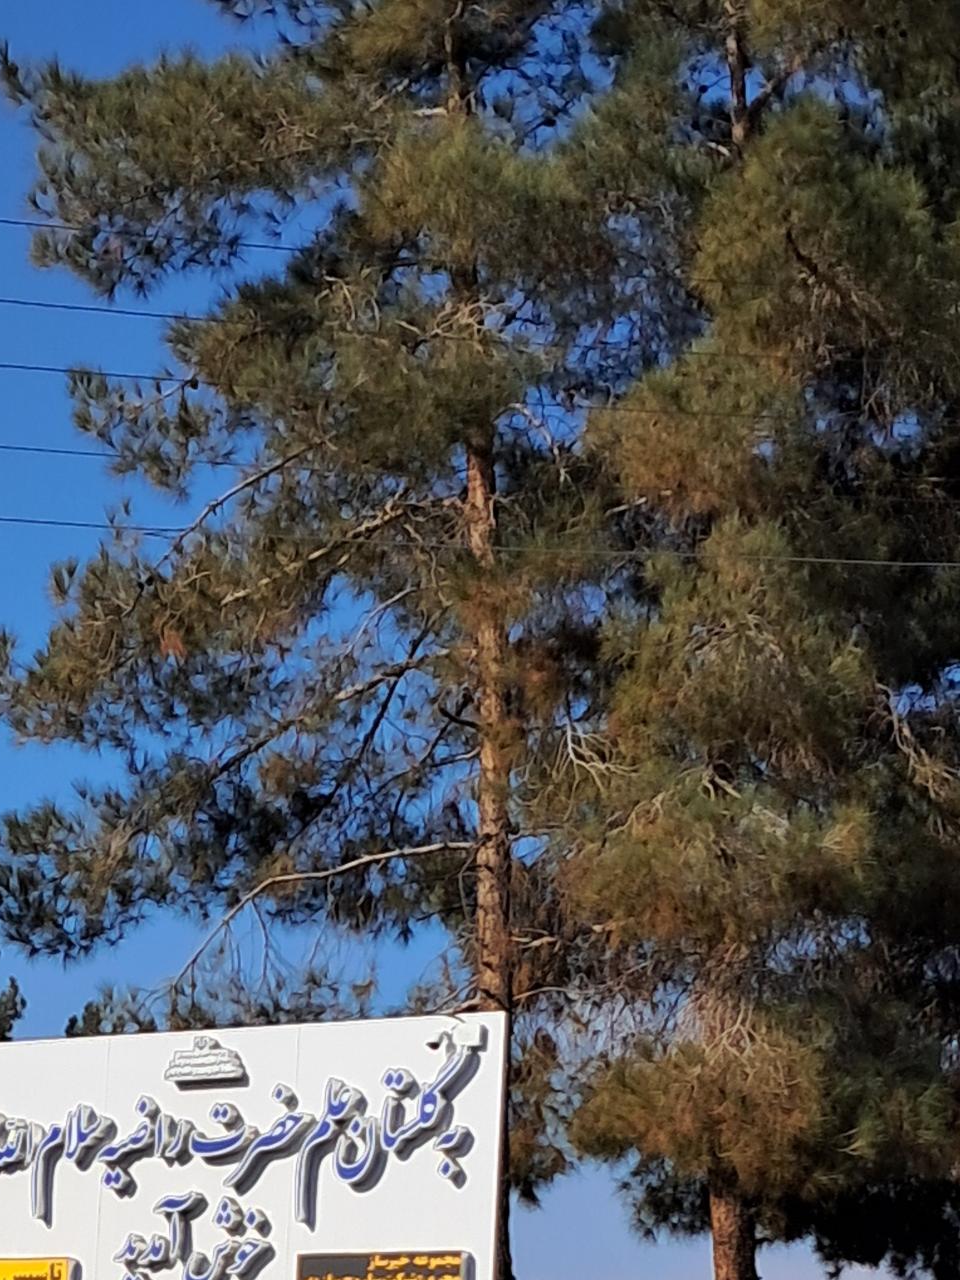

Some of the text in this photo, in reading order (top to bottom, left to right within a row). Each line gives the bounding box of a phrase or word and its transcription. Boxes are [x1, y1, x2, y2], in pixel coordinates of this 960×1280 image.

[31, 1104, 104, 1220] سلام
[97, 1097, 193, 1190] راضیه
[189, 1085, 306, 1188] حضرت
[295, 1078, 358, 1224] علم
[333, 1046, 470, 1185] گلستان
[434, 1127, 466, 1179] به
[413, 1255, 462, 1270] مجموعه
